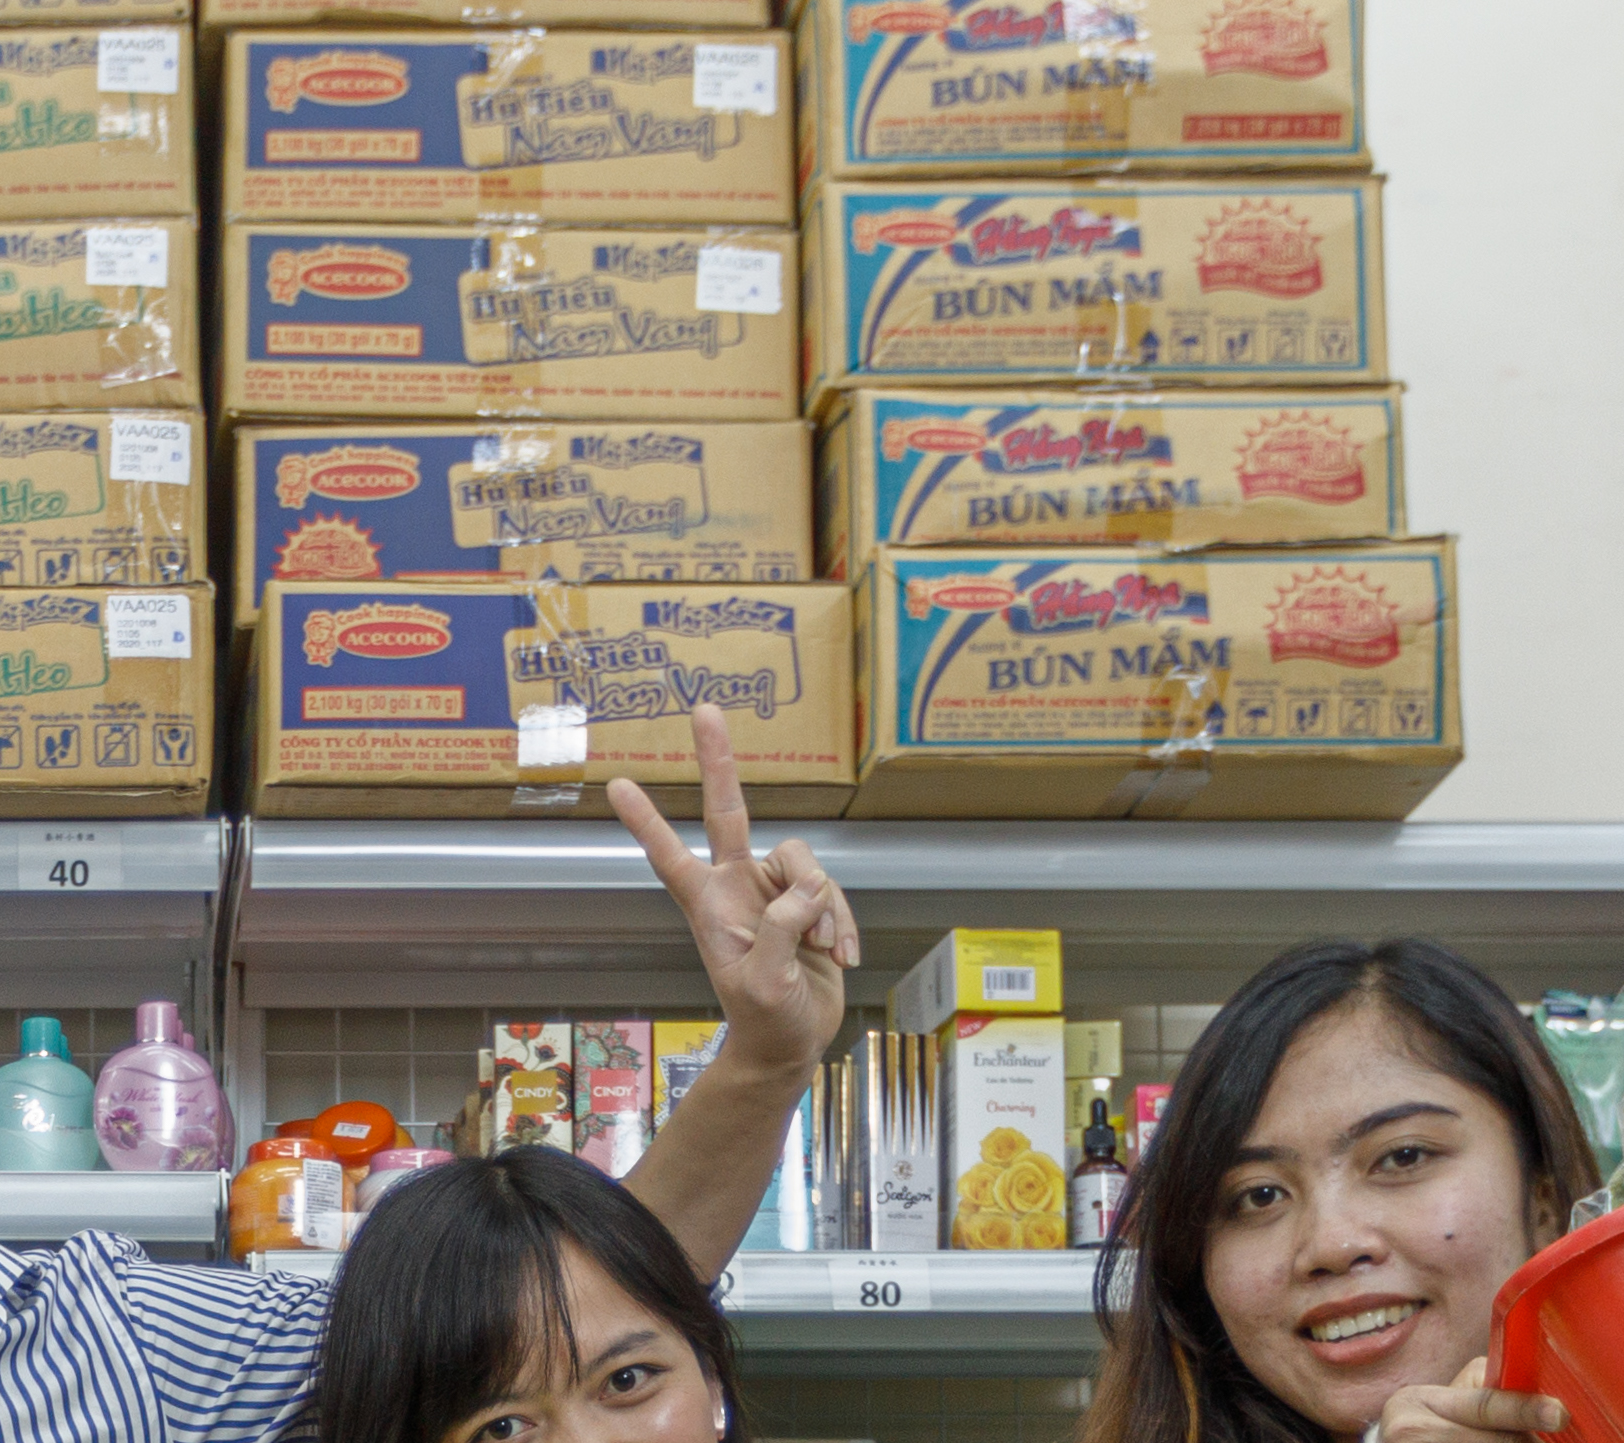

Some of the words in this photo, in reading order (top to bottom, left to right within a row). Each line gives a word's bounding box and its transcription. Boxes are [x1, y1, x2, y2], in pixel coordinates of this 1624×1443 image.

[114, 425, 181, 440] VAA025
[317, 470, 411, 491] ACECOOK
[965, 483, 1070, 529] BÚN
[110, 599, 178, 614] VAA025
[345, 629, 440, 647] ACECOOK
[987, 643, 1095, 696] BÚN
[48, 860, 90, 888] 40
[958, 1020, 984, 1039] NEW
[973, 1049, 1048, 1070] Enchanteur
[514, 1085, 554, 1100] CINDY
[592, 1085, 635, 1100] CINDY
[858, 1280, 902, 1309] 80
